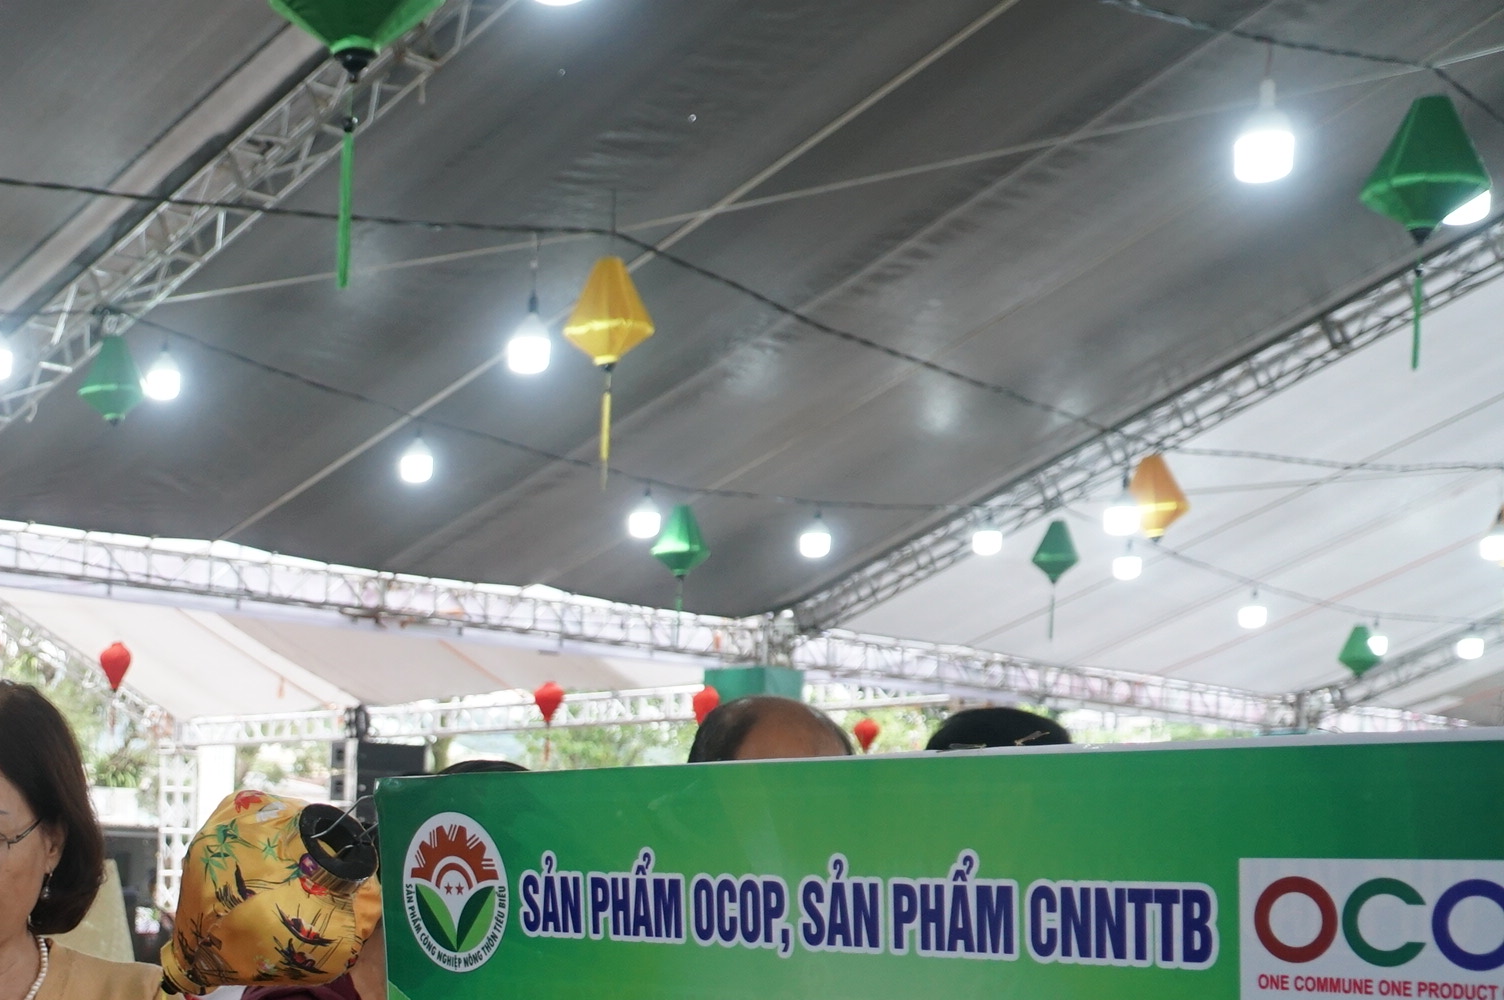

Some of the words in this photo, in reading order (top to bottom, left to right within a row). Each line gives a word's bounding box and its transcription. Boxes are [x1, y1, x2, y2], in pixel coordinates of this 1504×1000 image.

[521, 853, 584, 936] SẢN
[591, 850, 684, 940] PHẨM
[694, 875, 792, 955] OCOP,
[801, 857, 881, 949] SẢN
[892, 853, 1015, 956] PHẨM
[1029, 883, 1214, 965] CNNTTB
[436, 952, 462, 970] NGHIỆP
[1258, 974, 1289, 991] ONE
[1294, 975, 1374, 995] COMMUNE
[1379, 979, 1412, 997] ONE
[1417, 981, 1499, 1000] PRODUCT
